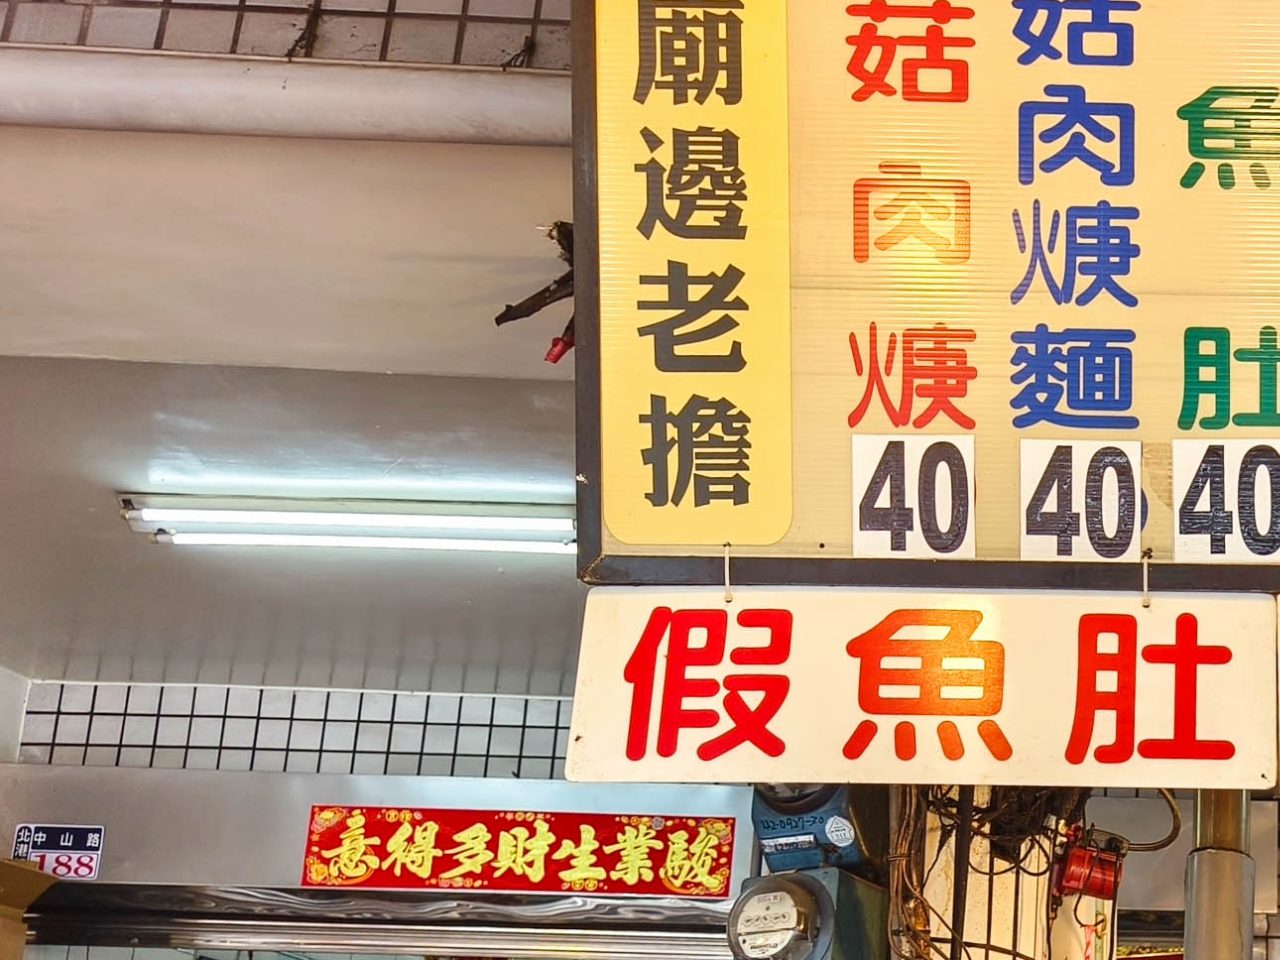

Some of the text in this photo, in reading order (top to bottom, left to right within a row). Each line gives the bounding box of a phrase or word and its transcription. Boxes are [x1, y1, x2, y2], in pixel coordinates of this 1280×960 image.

[858, 441, 971, 554] 40
[1025, 445, 1138, 558] 40
[624, 606, 1236, 764] 假魚肚
[34, 831, 100, 847] 中山路
[34, 853, 94, 877] 188
